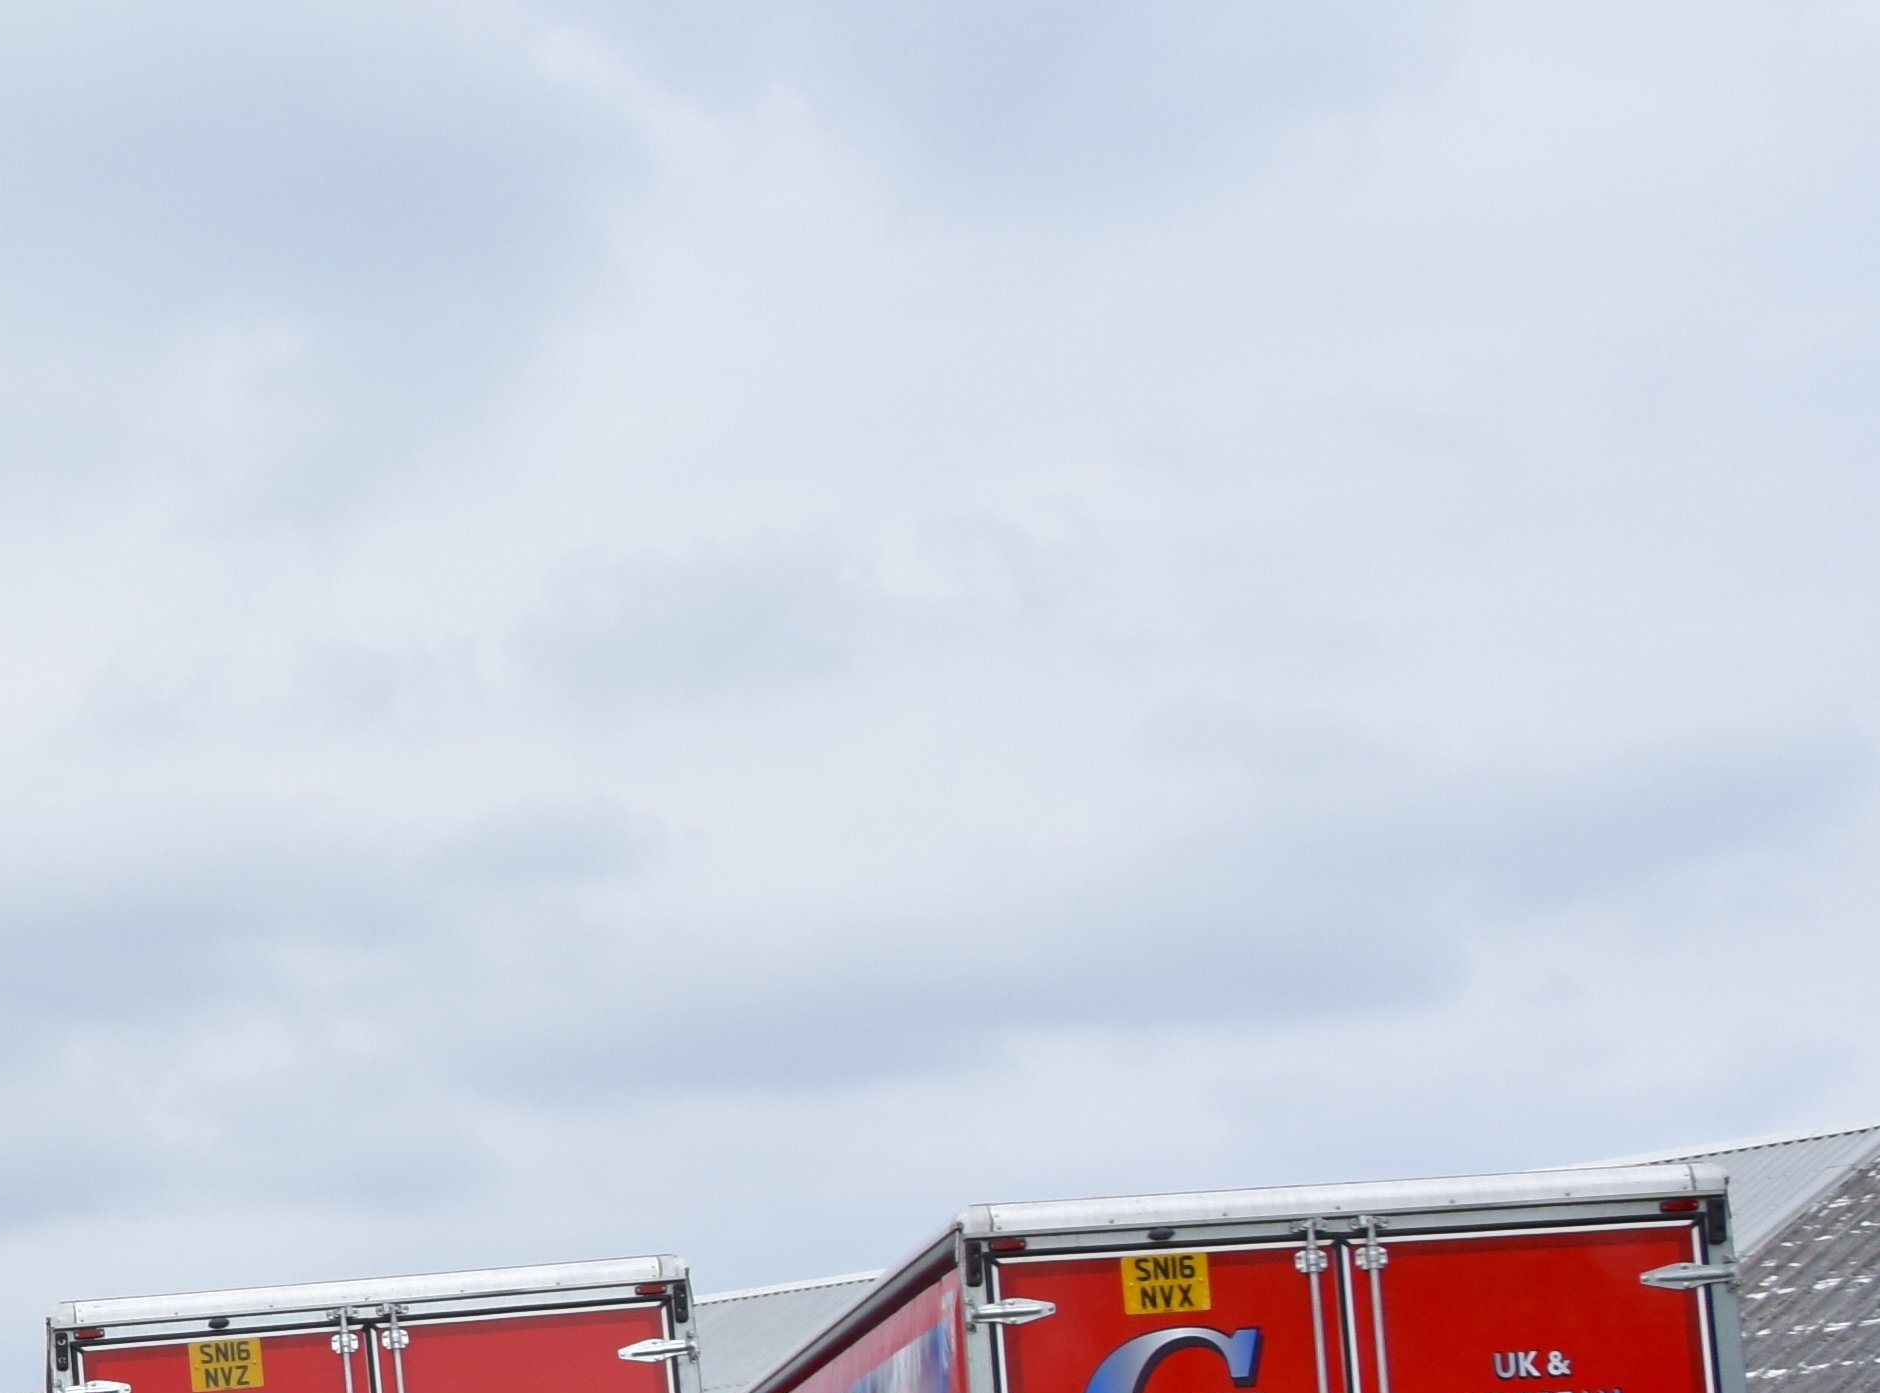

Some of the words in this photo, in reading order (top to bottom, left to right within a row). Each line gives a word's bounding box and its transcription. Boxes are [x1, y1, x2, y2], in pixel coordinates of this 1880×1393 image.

[1134, 1255, 1195, 1281] SN16
[1140, 1284, 1194, 1309] NVX
[200, 1341, 250, 1364] SN16
[1493, 1350, 1542, 1378] UK
[1547, 1350, 1571, 1376] &
[204, 1365, 250, 1388] NVZ
